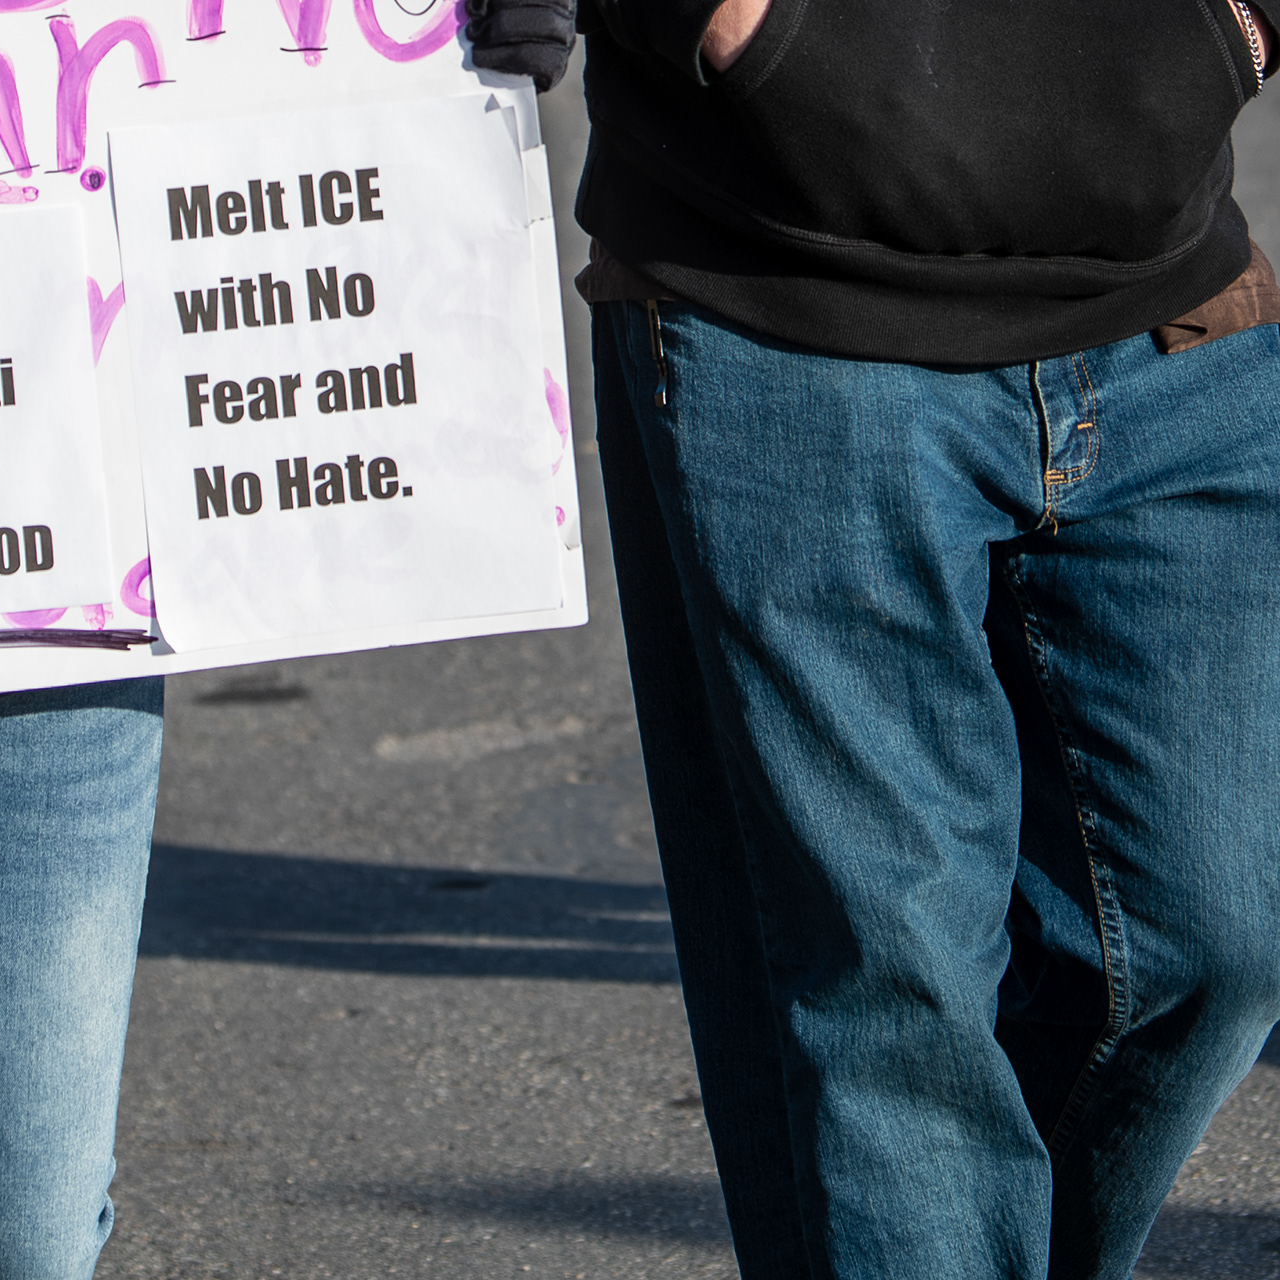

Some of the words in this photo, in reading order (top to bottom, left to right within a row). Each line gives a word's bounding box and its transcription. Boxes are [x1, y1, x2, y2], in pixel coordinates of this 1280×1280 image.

[167, 180, 288, 240] Melt
[299, 168, 383, 227] ICE
[175, 273, 293, 333] with
[306, 267, 374, 321] No
[185, 374, 301, 427] Fear
[316, 353, 416, 413] and
[194, 466, 262, 519] No
[276, 455, 412, 511] Hate.
